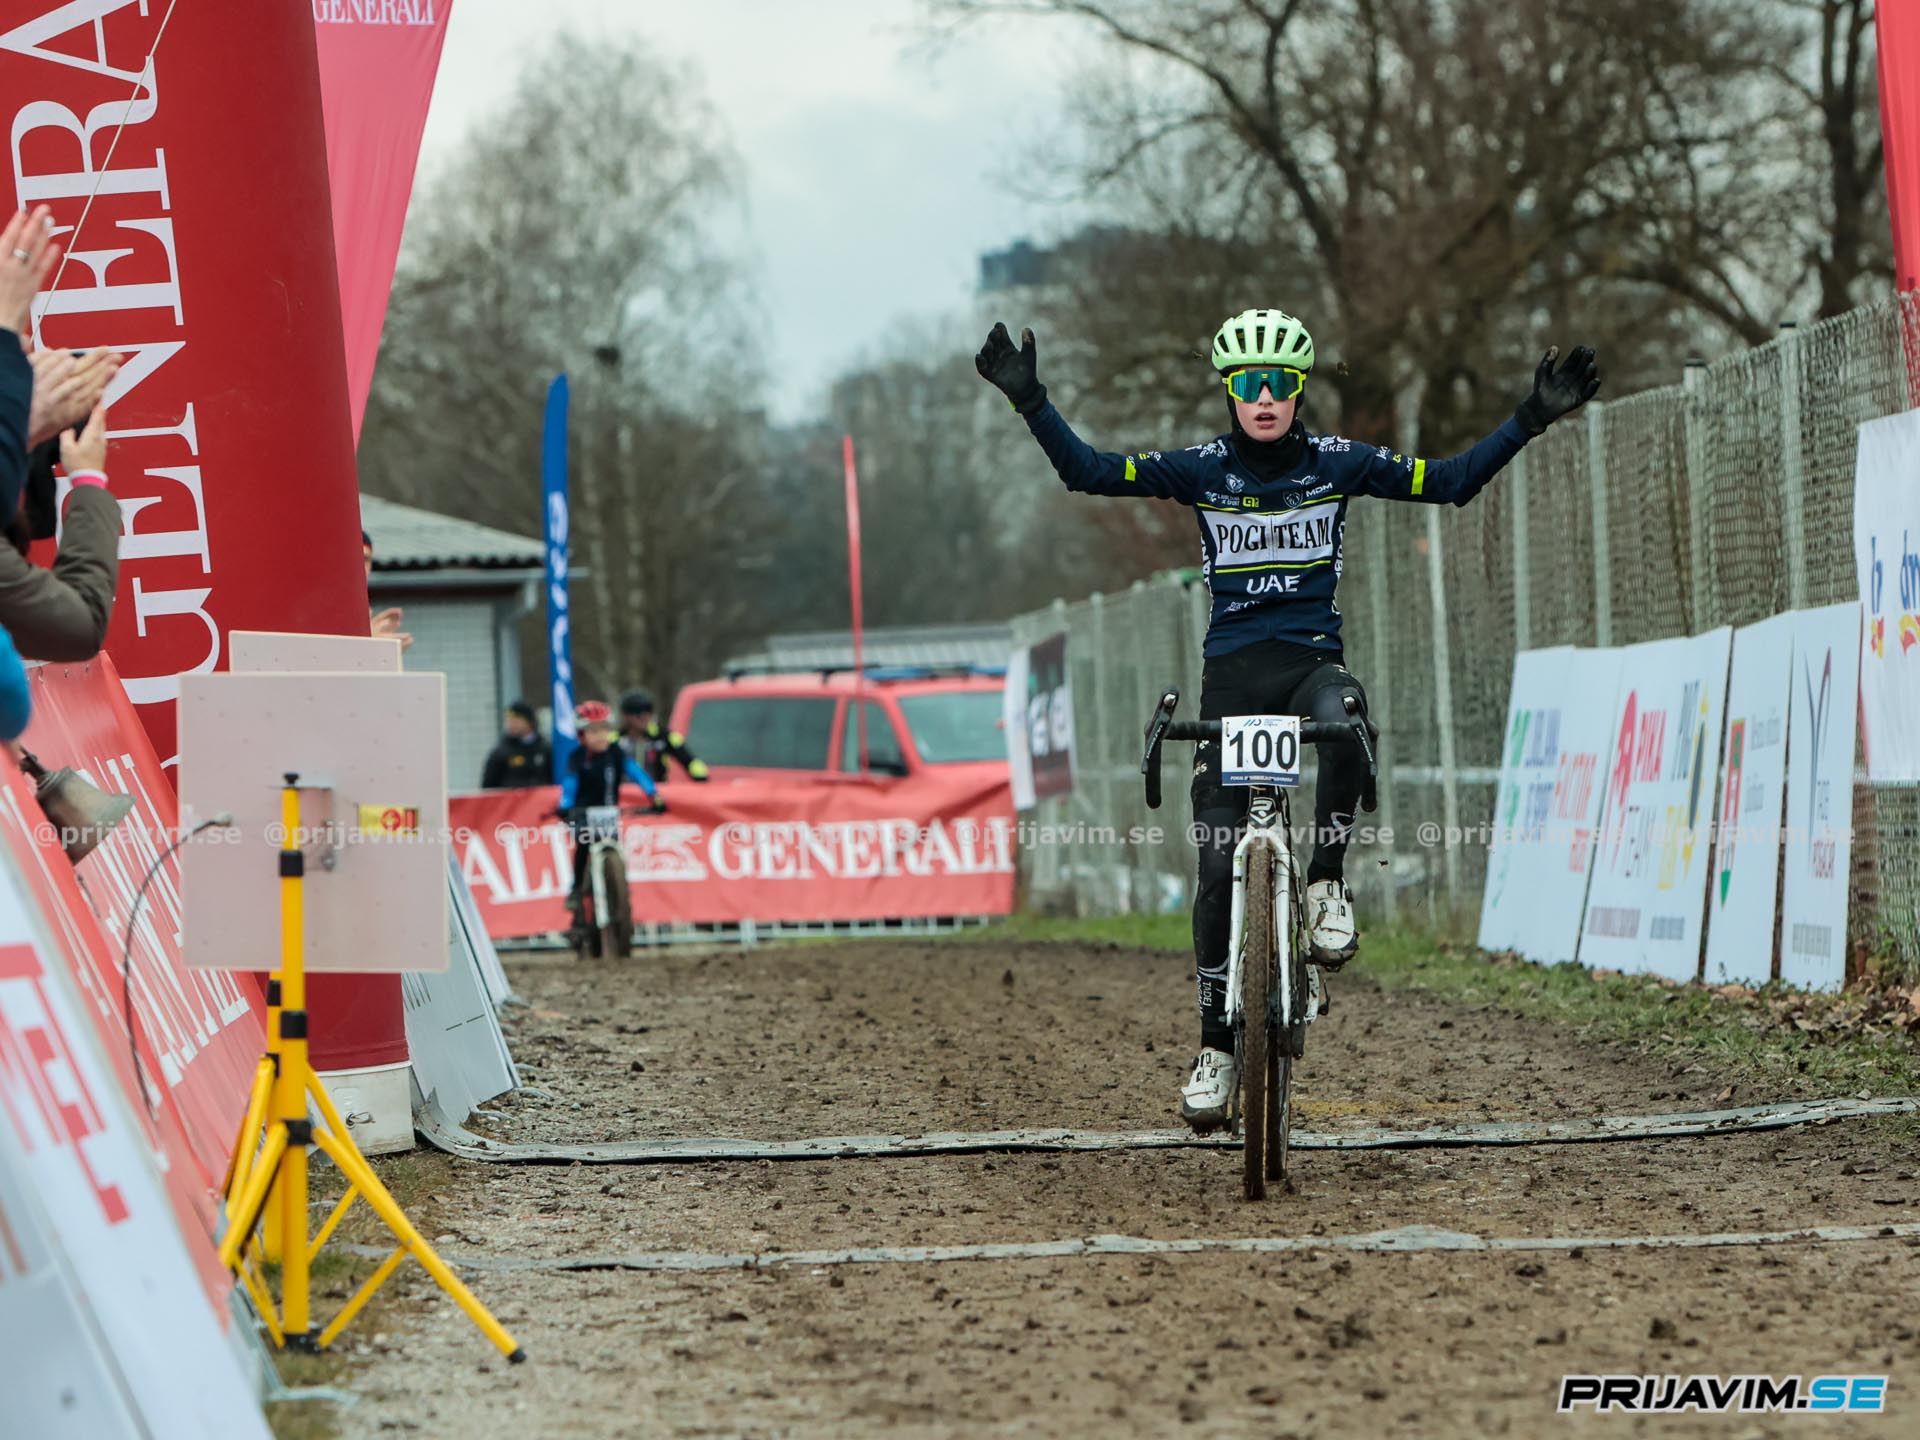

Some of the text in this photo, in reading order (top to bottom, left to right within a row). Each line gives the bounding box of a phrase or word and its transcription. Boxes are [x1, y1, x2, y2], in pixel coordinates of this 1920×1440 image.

[1305, 482, 1333, 498] MDM
[1215, 524, 1268, 554] POGI
[1273, 516, 1331, 549] TEAM
[1246, 574, 1301, 595] UAE
[1229, 729, 1297, 770] 100
[708, 814, 1016, 881] GENERALI
[1202, 981, 1212, 1007] TADEJ
